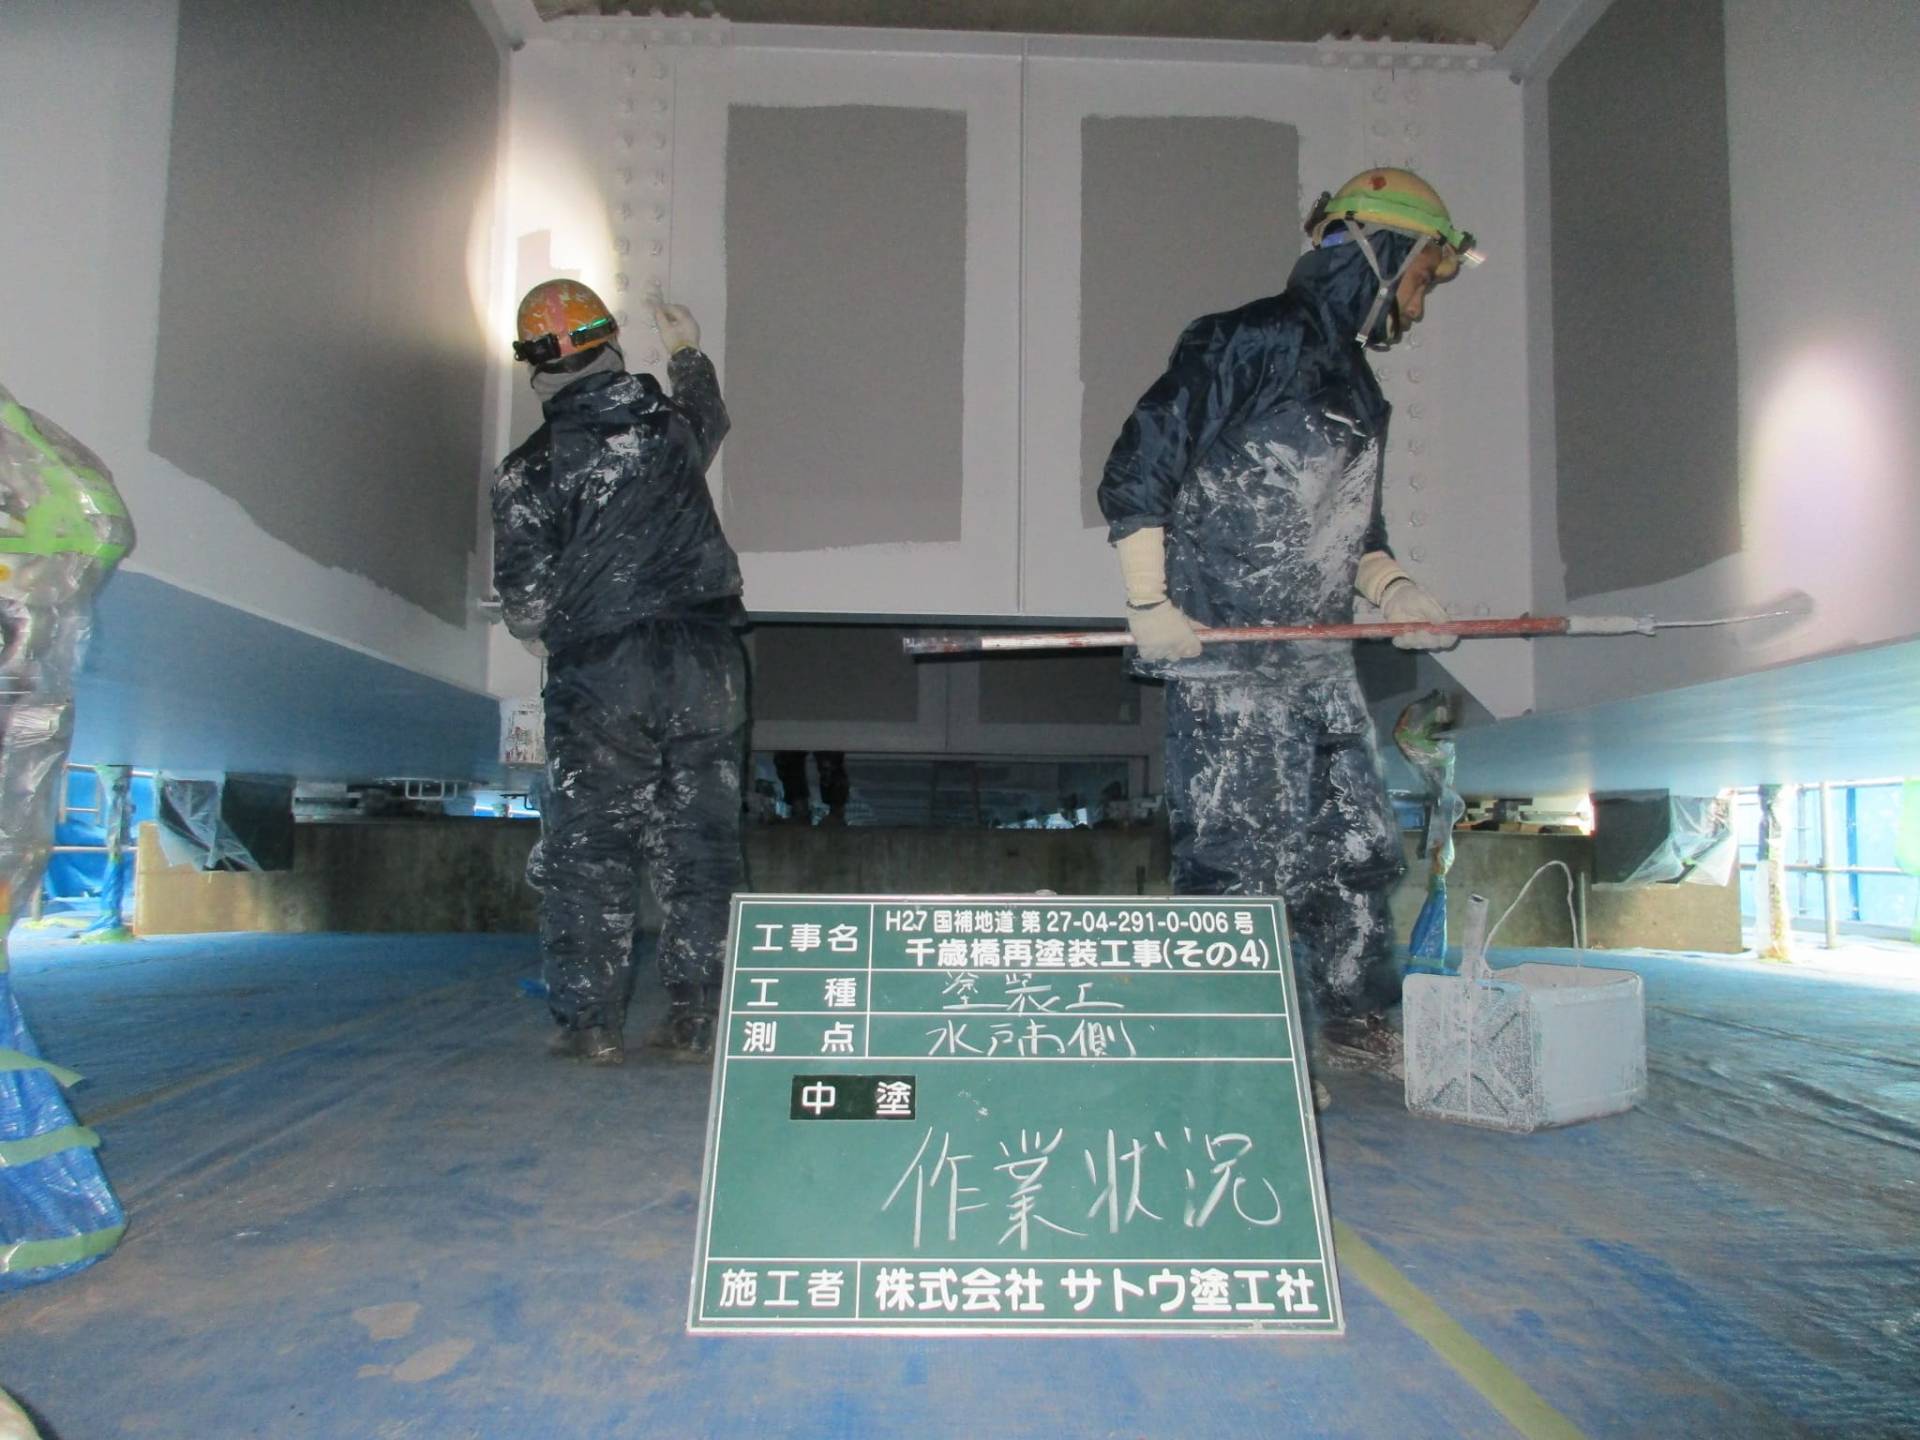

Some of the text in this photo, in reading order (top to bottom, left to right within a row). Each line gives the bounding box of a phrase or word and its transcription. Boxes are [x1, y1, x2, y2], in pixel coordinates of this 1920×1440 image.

[752, 923, 858, 952] 工事名
[886, 910, 928, 932] H27
[905, 938, 1269, 969] 千歳橋再塗装工事(その4)
[881, 1126, 1282, 1251] 作業状況
[719, 1268, 844, 1308] 施工者
[875, 1267, 1319, 1312] 株式会社 サトウ塗工社
